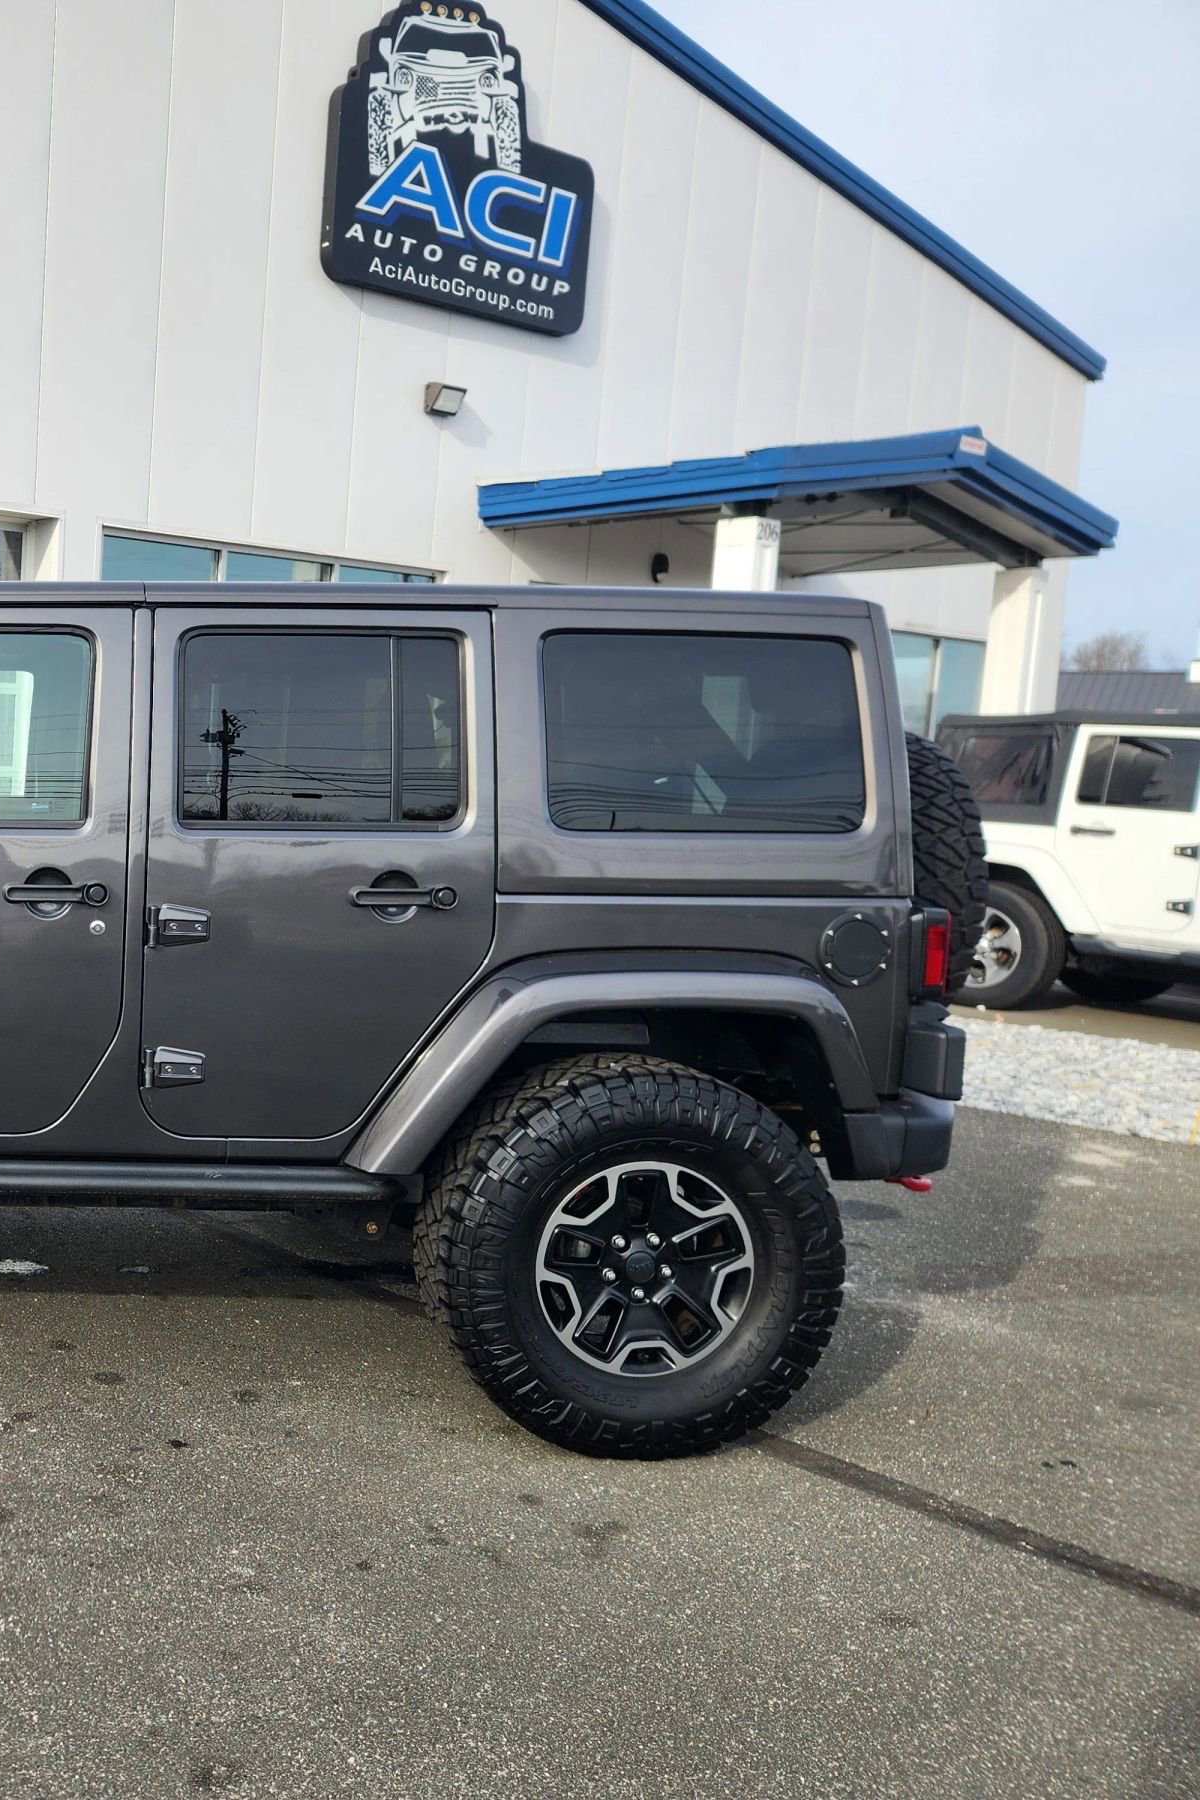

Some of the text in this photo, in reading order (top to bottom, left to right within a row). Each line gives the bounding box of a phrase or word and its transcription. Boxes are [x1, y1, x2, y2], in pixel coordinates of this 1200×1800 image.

[355, 140, 577, 267] ACI
[345, 223, 571, 296] AUTO GROUP
[368, 257, 555, 320] AciAutoGroup.com
